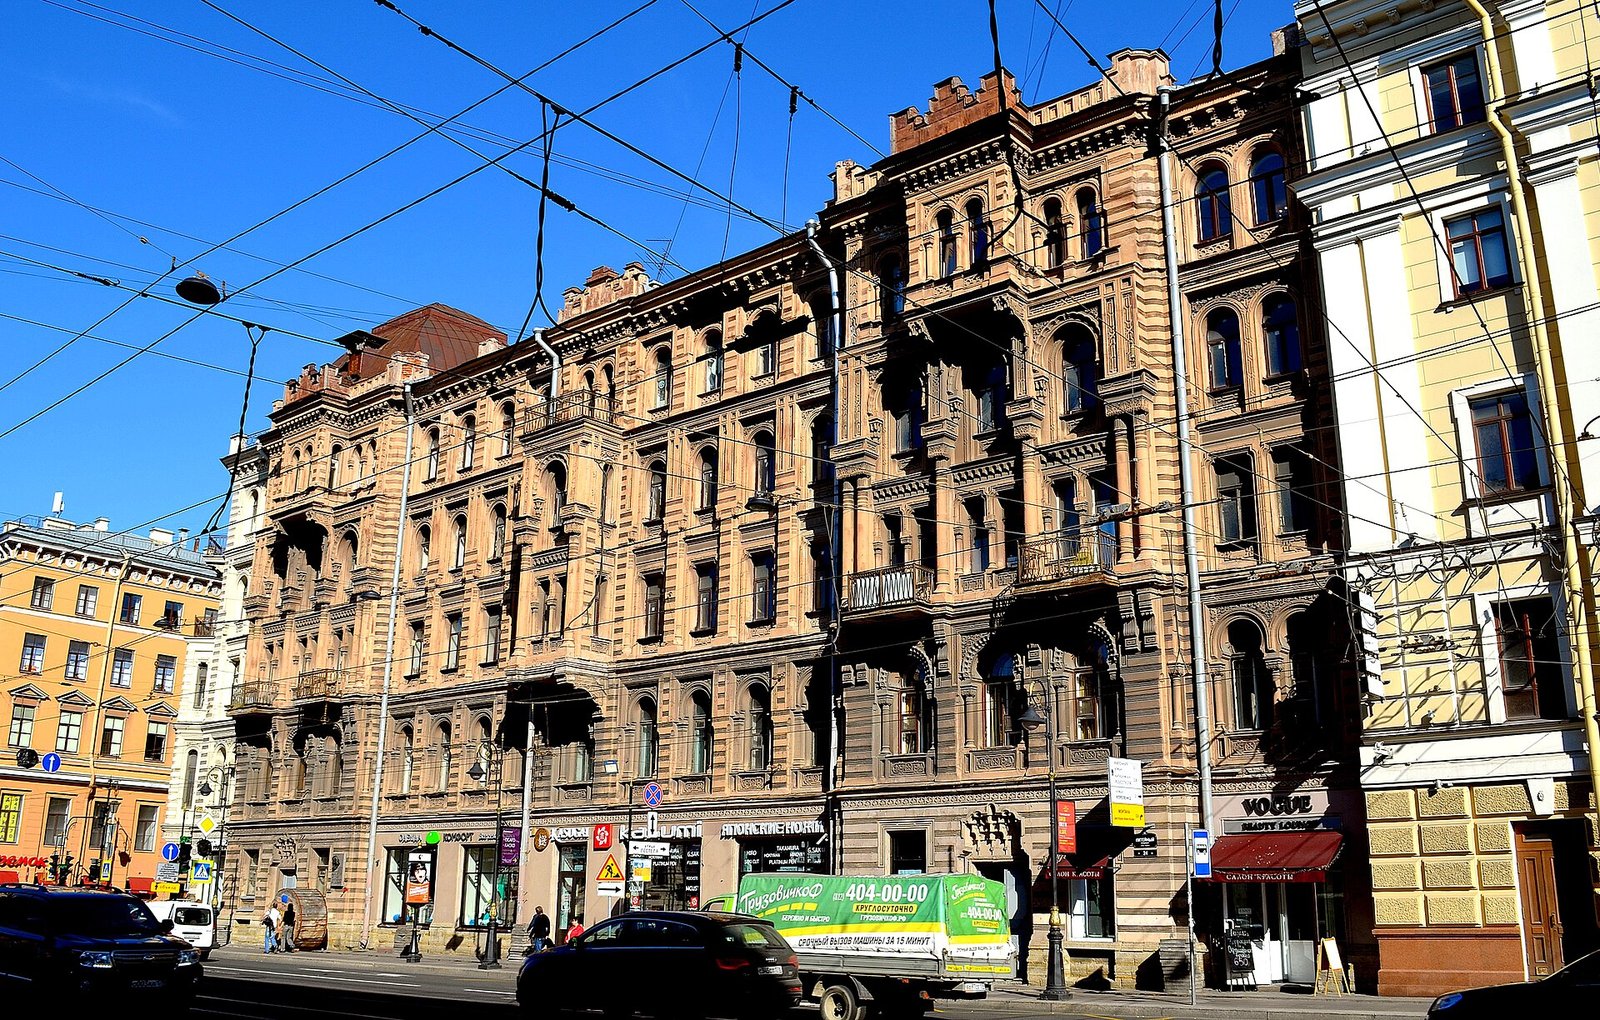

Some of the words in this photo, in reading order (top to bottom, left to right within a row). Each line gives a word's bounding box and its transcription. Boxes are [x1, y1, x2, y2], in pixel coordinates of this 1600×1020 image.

[1241, 795, 1313, 817] VOGUE
[619, 821, 703, 840] kaumi
[721, 823, 785, 836] ЯПОНСКИЕ
[785, 821, 825, 834] НОЖИ
[846, 884, 928, 902] 404-00-00
[855, 904, 914, 913] КРУГЛОСУТОЧНО
[798, 936, 829, 947] СРОЧНЫЙ
[829, 936, 852, 945] ВЫЗОВ
[853, 936, 885, 945] МАШИНЫ
[886, 936, 895, 945] ЗА
[896, 936, 905, 945] 15
[906, 936, 931, 945] МИНУТ
